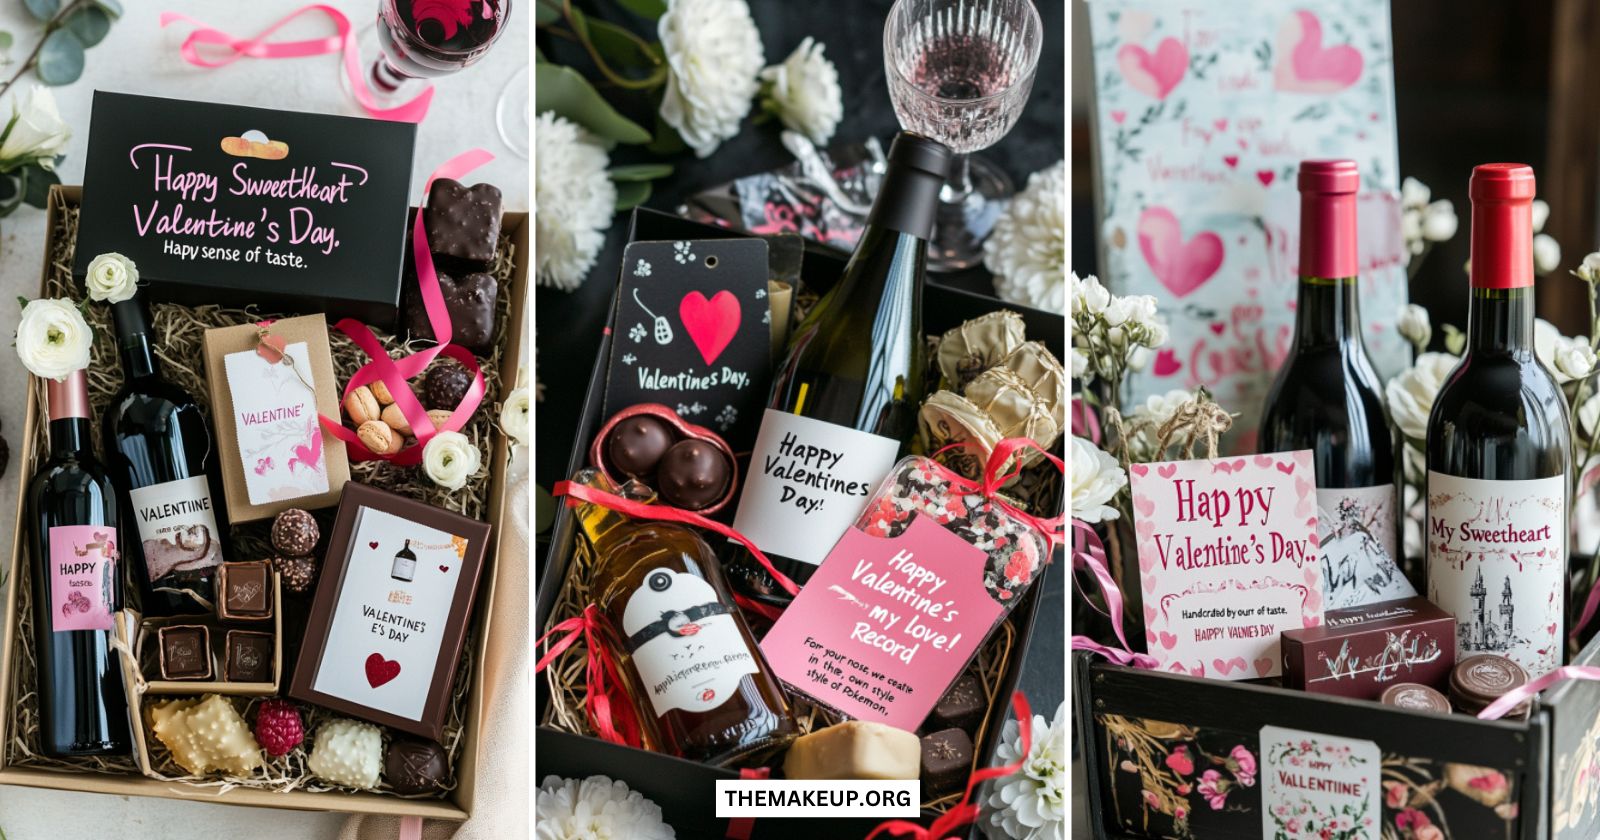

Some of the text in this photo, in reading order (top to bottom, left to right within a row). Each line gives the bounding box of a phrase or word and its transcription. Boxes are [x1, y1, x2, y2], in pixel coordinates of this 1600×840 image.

[154, 153, 218, 203] Happy
[133, 200, 340, 255] Valentine's Day.
[201, 246, 240, 261] sense
[245, 246, 261, 262] of
[265, 249, 308, 269] taste.
[638, 366, 718, 391] Valentines
[779, 431, 844, 470] Happy
[1431, 516, 1551, 544] My Sweetheart
[1153, 533, 1265, 571] Valentine's
[60, 562, 96, 575] HAPPY
[888, 548, 947, 595] Happy
[850, 559, 959, 622] Valentine's
[868, 605, 901, 631] my
[1226, 607, 1236, 619] by
[1257, 605, 1265, 615] of
[388, 629, 410, 643] DAY
[850, 622, 921, 665] Record
[1260, 623, 1275, 637] DAY
[806, 669, 829, 685] style
[831, 681, 843, 691] of
[808, 653, 819, 665] in
[848, 675, 869, 689] own
[872, 686, 895, 703] style
[823, 648, 847, 663] your
[871, 671, 885, 682] we
